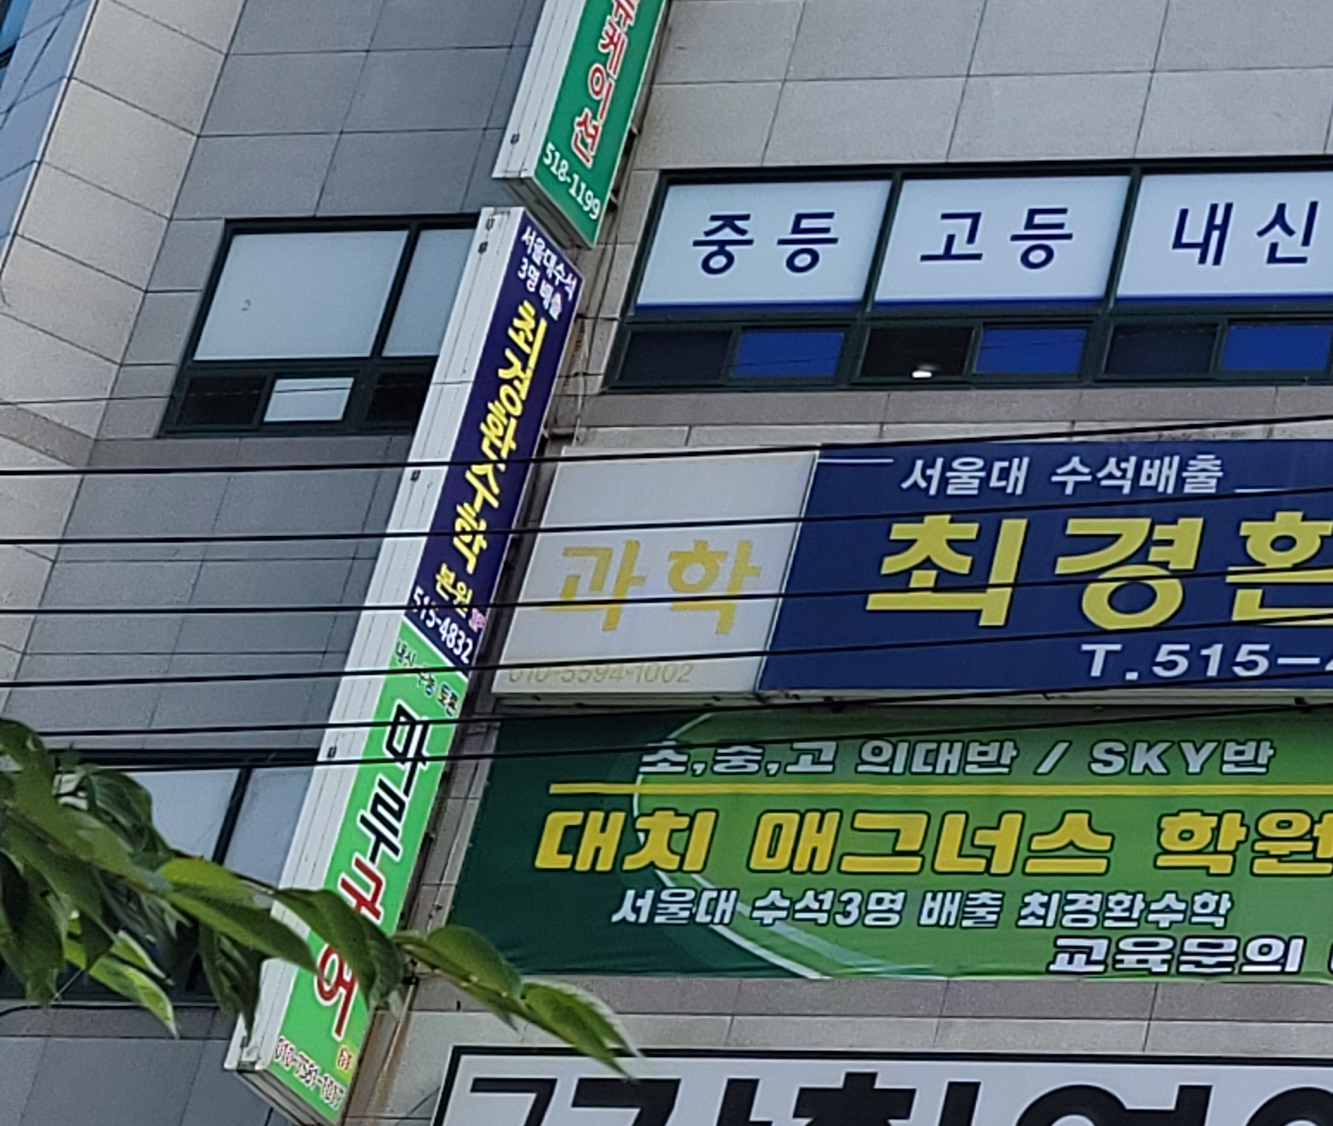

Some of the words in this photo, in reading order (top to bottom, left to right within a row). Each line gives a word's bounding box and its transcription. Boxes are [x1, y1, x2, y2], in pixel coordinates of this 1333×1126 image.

[542, 141, 602, 221] 518-1199
[692, 211, 840, 275] 중등
[919, 207, 1074, 270] 고등
[1171, 200, 1320, 267] 내신
[901, 457, 1030, 498] 서울대
[1049, 452, 1225, 497] 수석배출
[538, 538, 761, 637] 과학
[856, 739, 1019, 778] 의대반
[1092, 739, 1275, 778] SKY반
[535, 809, 716, 876] 대치
[749, 809, 1112, 878] 매그너스
[611, 889, 738, 927] 서울대
[749, 890, 905, 929] 수석3명
[917, 889, 1004, 930] 배출
[1017, 890, 1234, 931] 최경환수학
[1048, 935, 1303, 977] 교육문의
